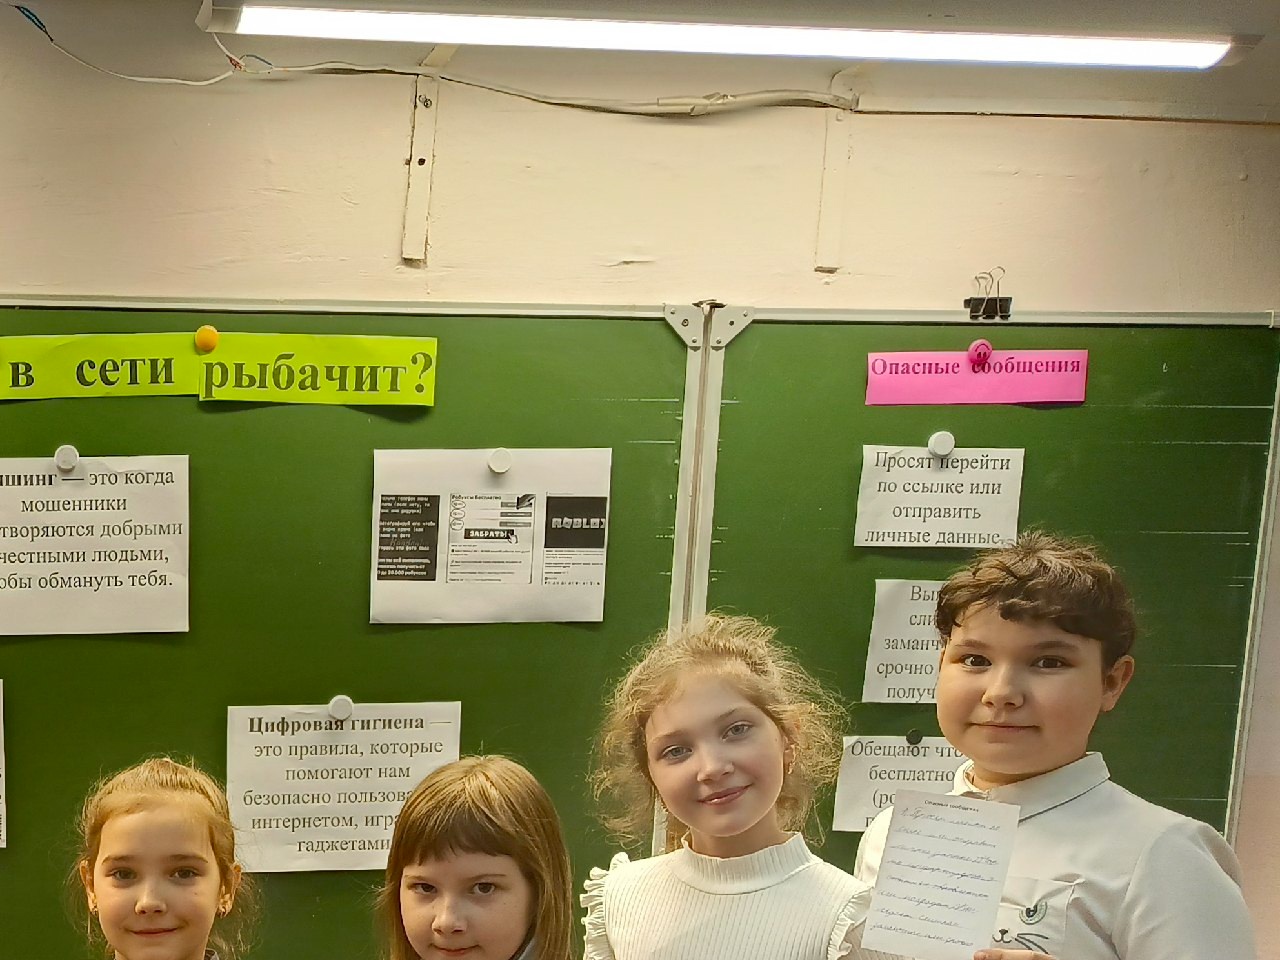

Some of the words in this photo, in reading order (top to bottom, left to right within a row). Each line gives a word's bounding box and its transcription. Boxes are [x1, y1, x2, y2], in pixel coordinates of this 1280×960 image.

[9, 360, 35, 389] в
[74, 353, 175, 388] сети
[202, 350, 433, 399] рыбачит?
[871, 357, 960, 375] Опасные
[971, 357, 1081, 375] сообщения
[874, 451, 935, 472] Просят
[940, 453, 1011, 473] перейти
[89, 472, 118, 486] это
[124, 470, 175, 486] когда
[877, 481, 897, 493] по
[902, 481, 964, 494] ссылке
[970, 482, 1002, 495] или
[21, 498, 127, 513] мошенники
[892, 504, 982, 521] отправить
[100, 519, 183, 540] добрыми
[865, 530, 931, 543] личные
[91, 548, 169, 564] людьми,
[38, 571, 123, 592] обмануть
[128, 570, 173, 588] тебя.
[884, 638, 941, 651] заманч
[877, 662, 934, 678] срочно
[887, 686, 936, 703] получ
[248, 716, 344, 736] Цифровая
[351, 717, 424, 731] гигиена
[254, 744, 282, 757] это
[288, 743, 364, 760] правила,
[369, 740, 443, 757] которые
[851, 740, 930, 758] Обещают
[285, 765, 372, 780] помогают
[378, 765, 411, 779] нам
[869, 764, 955, 782] бесплатно
[243, 789, 331, 806] безопасно
[337, 790, 412, 804] пользова
[251, 815, 358, 832] интернетом,
[365, 813, 399, 830] игра
